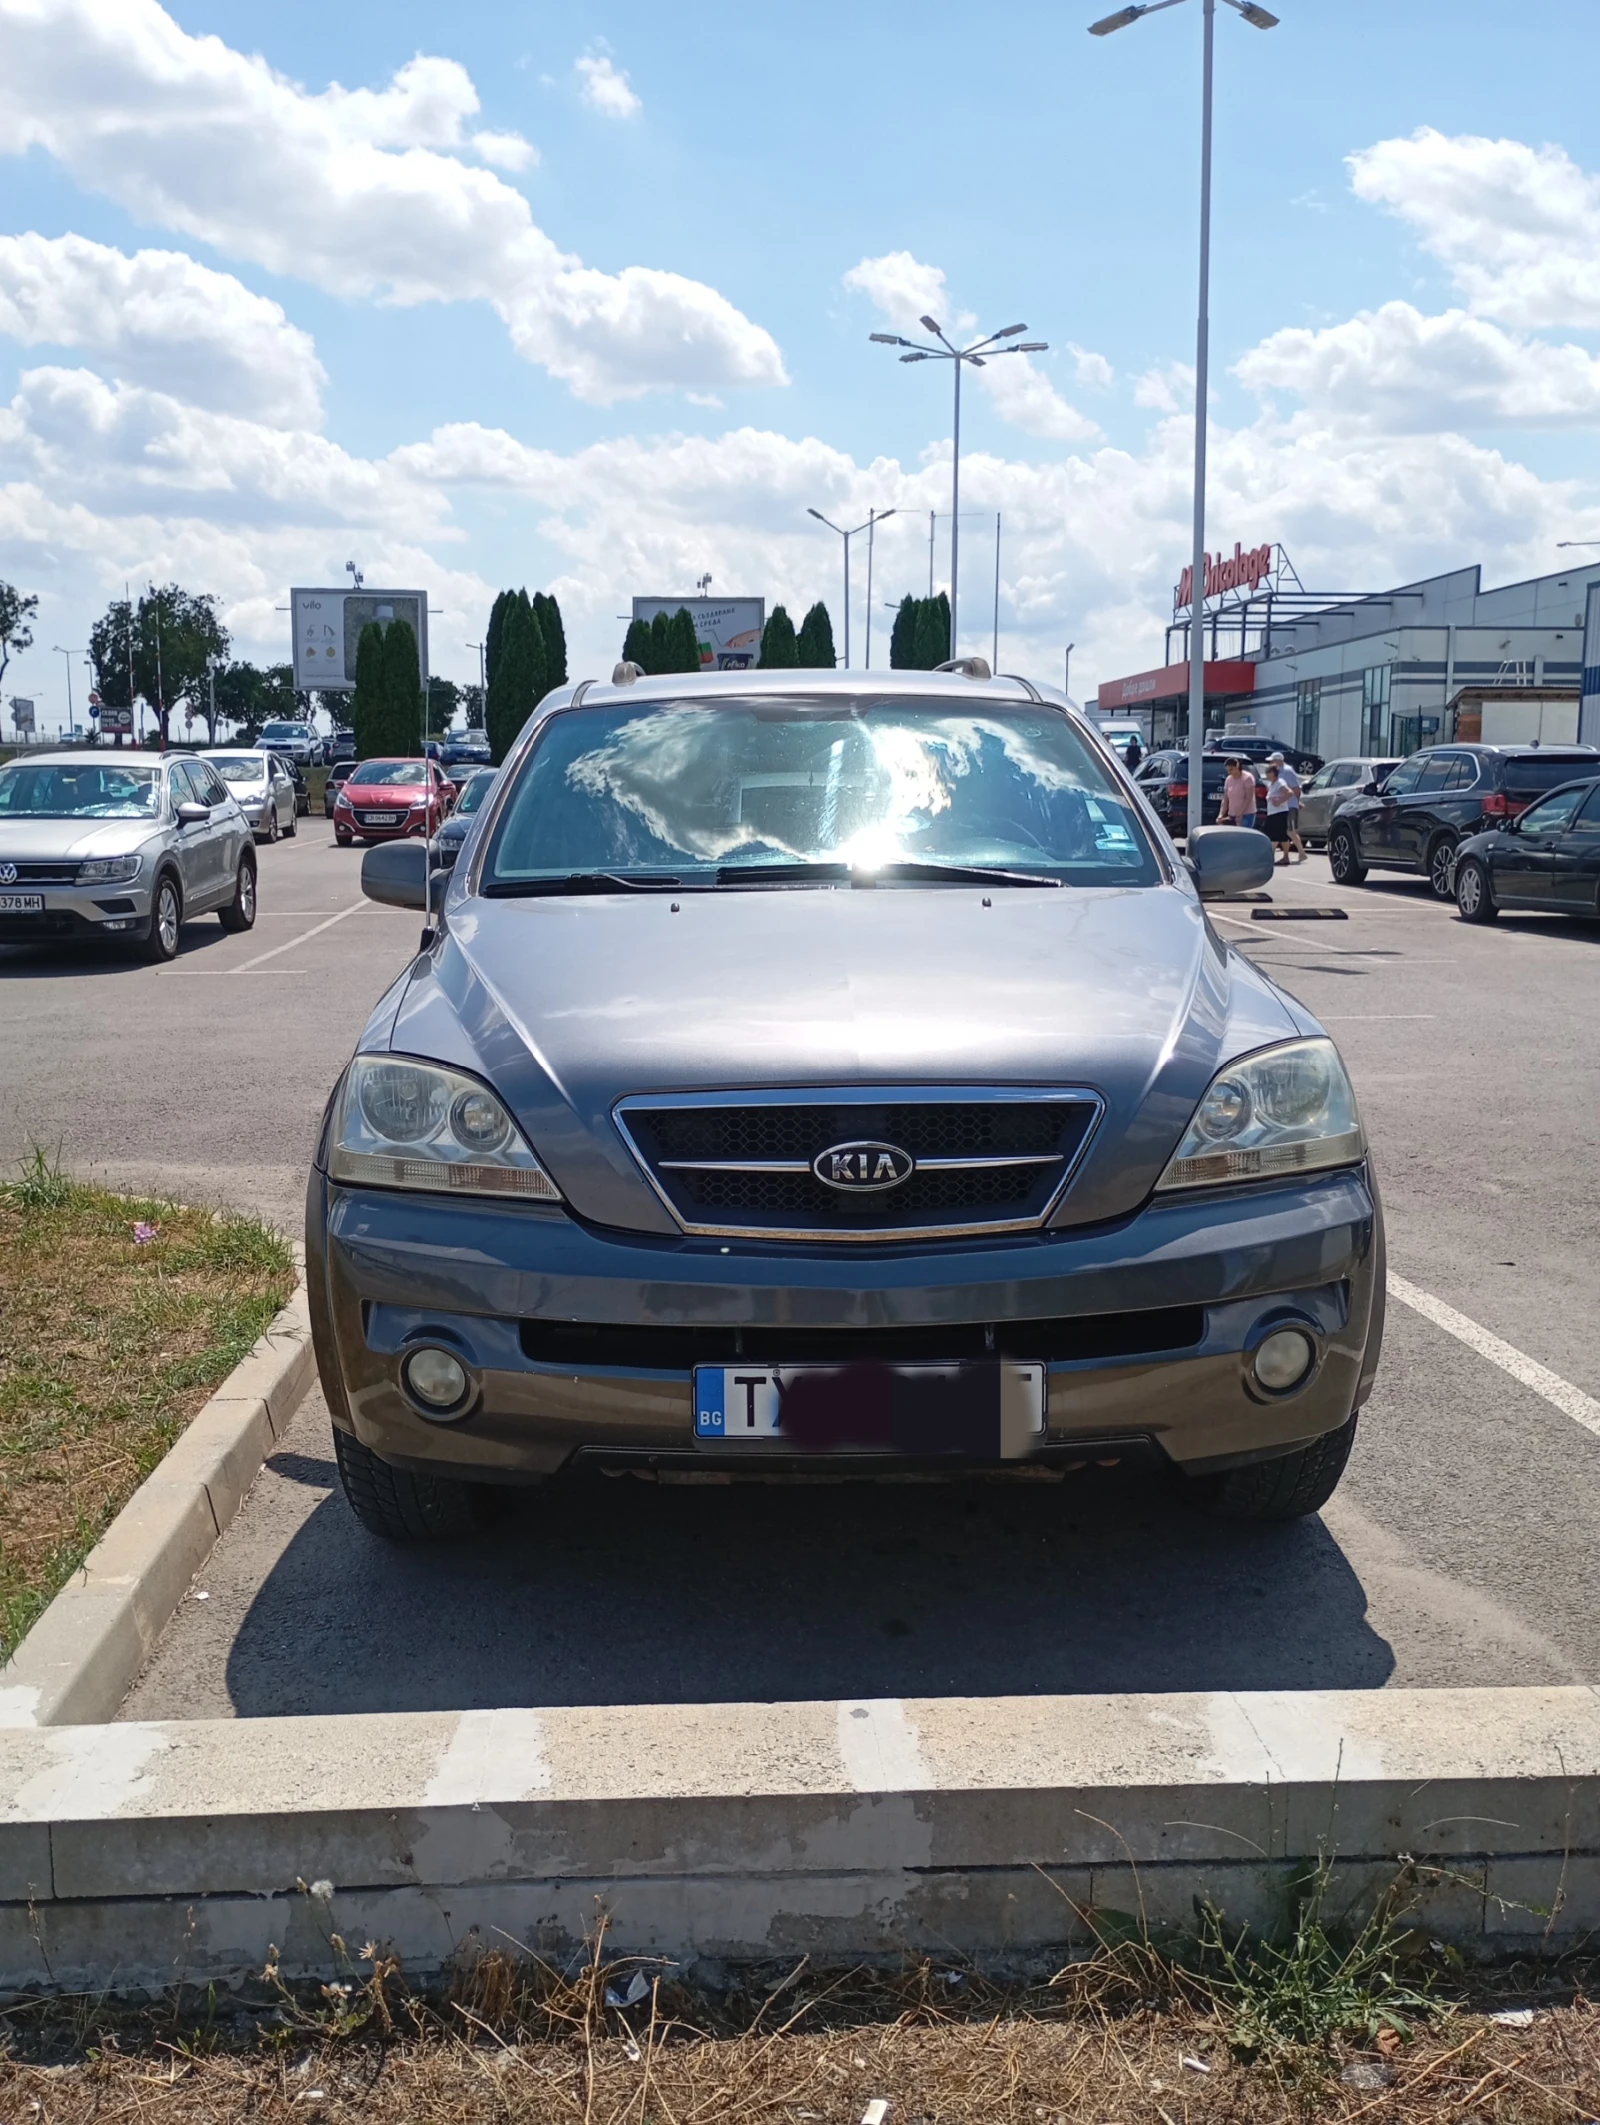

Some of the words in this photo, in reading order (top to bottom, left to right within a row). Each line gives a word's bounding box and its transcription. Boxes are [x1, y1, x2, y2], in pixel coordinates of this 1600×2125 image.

[302, 600, 322, 610] vilo
[0, 897, 21, 909] 378
[830, 1153, 898, 1179] KIA
[700, 1411, 722, 1426] BG
